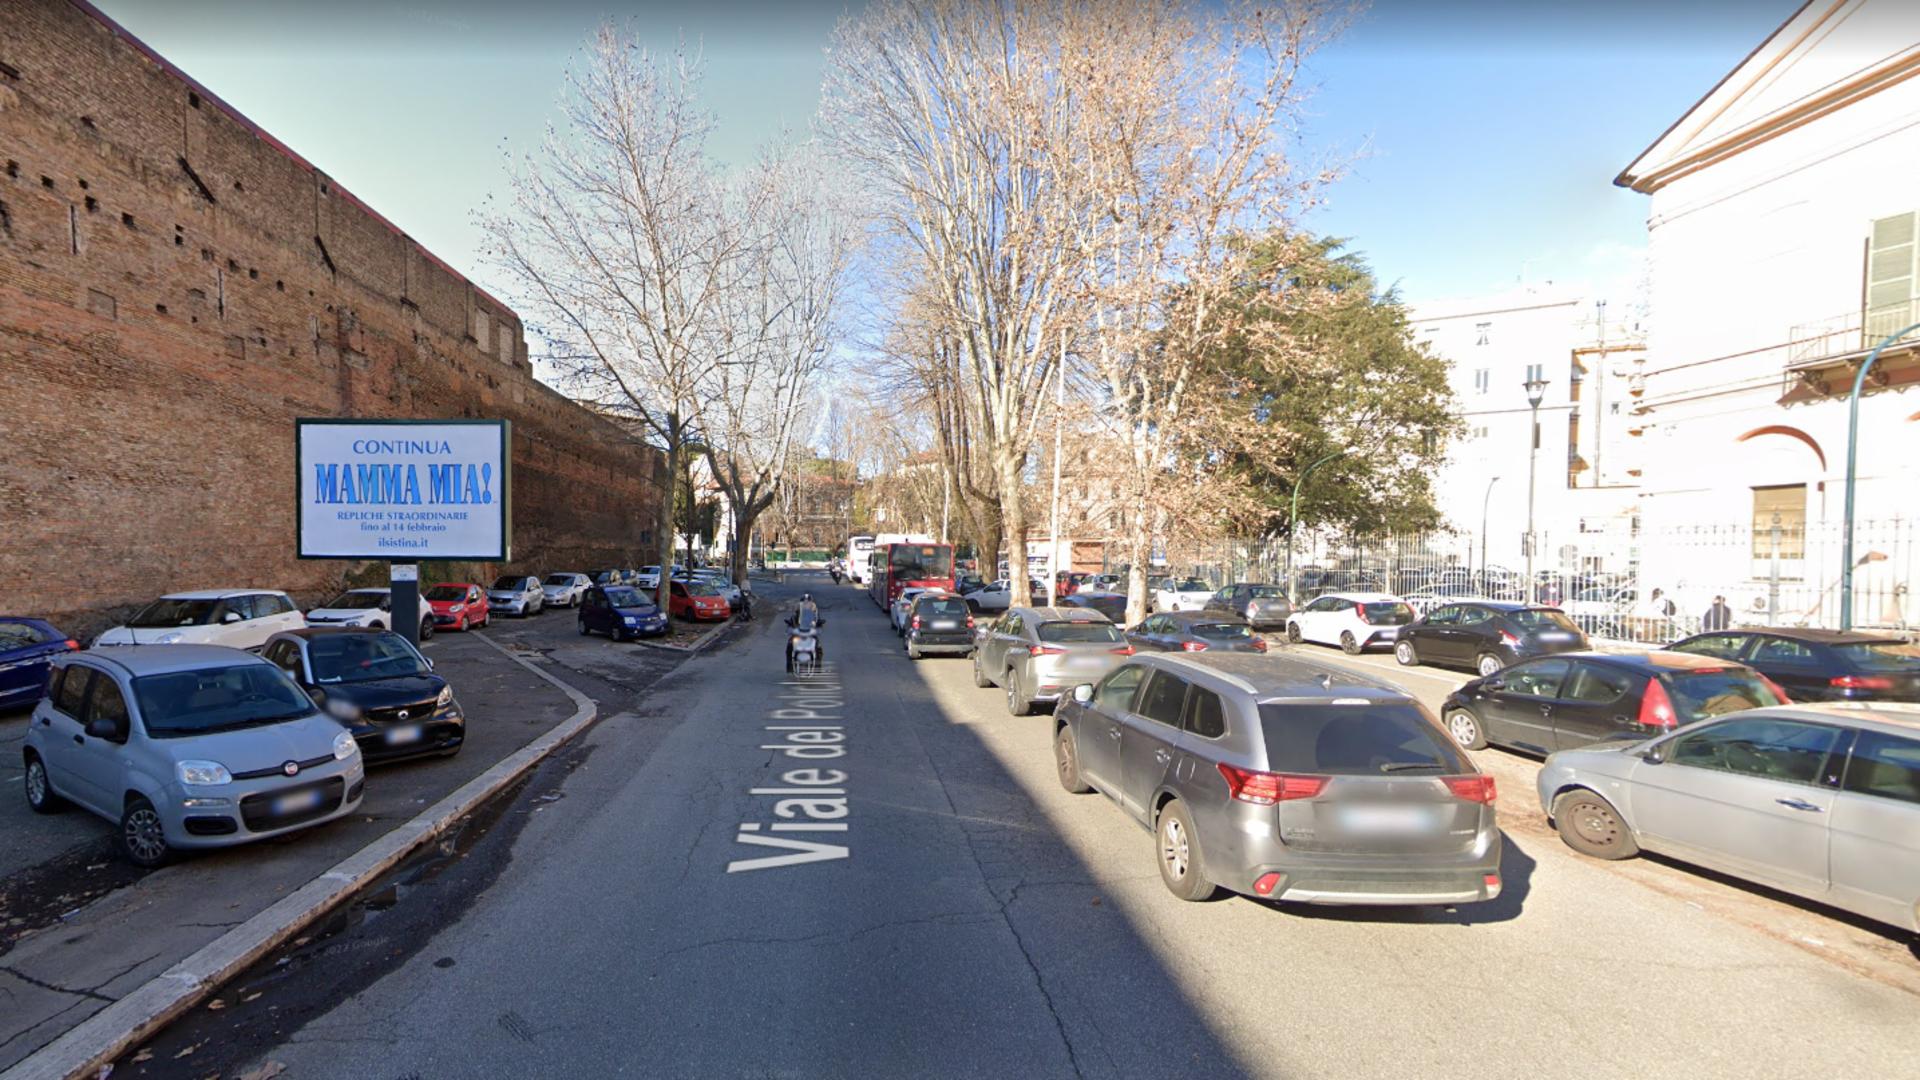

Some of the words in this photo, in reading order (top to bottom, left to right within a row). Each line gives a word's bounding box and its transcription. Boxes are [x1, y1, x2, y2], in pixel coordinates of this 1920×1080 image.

[352, 439, 452, 455] CONTINUA
[314, 463, 422, 504] MAMMA
[428, 462, 492, 504] MIA!
[337, 511, 384, 520] REPLICHE
[387, 511, 469, 520] STRAORDINARIE
[360, 522, 379, 531] fino
[381, 522, 391, 531] al
[394, 522, 404, 531] 14
[407, 522, 447, 531] febbraio
[378, 537, 429, 548] ilsistina.it
